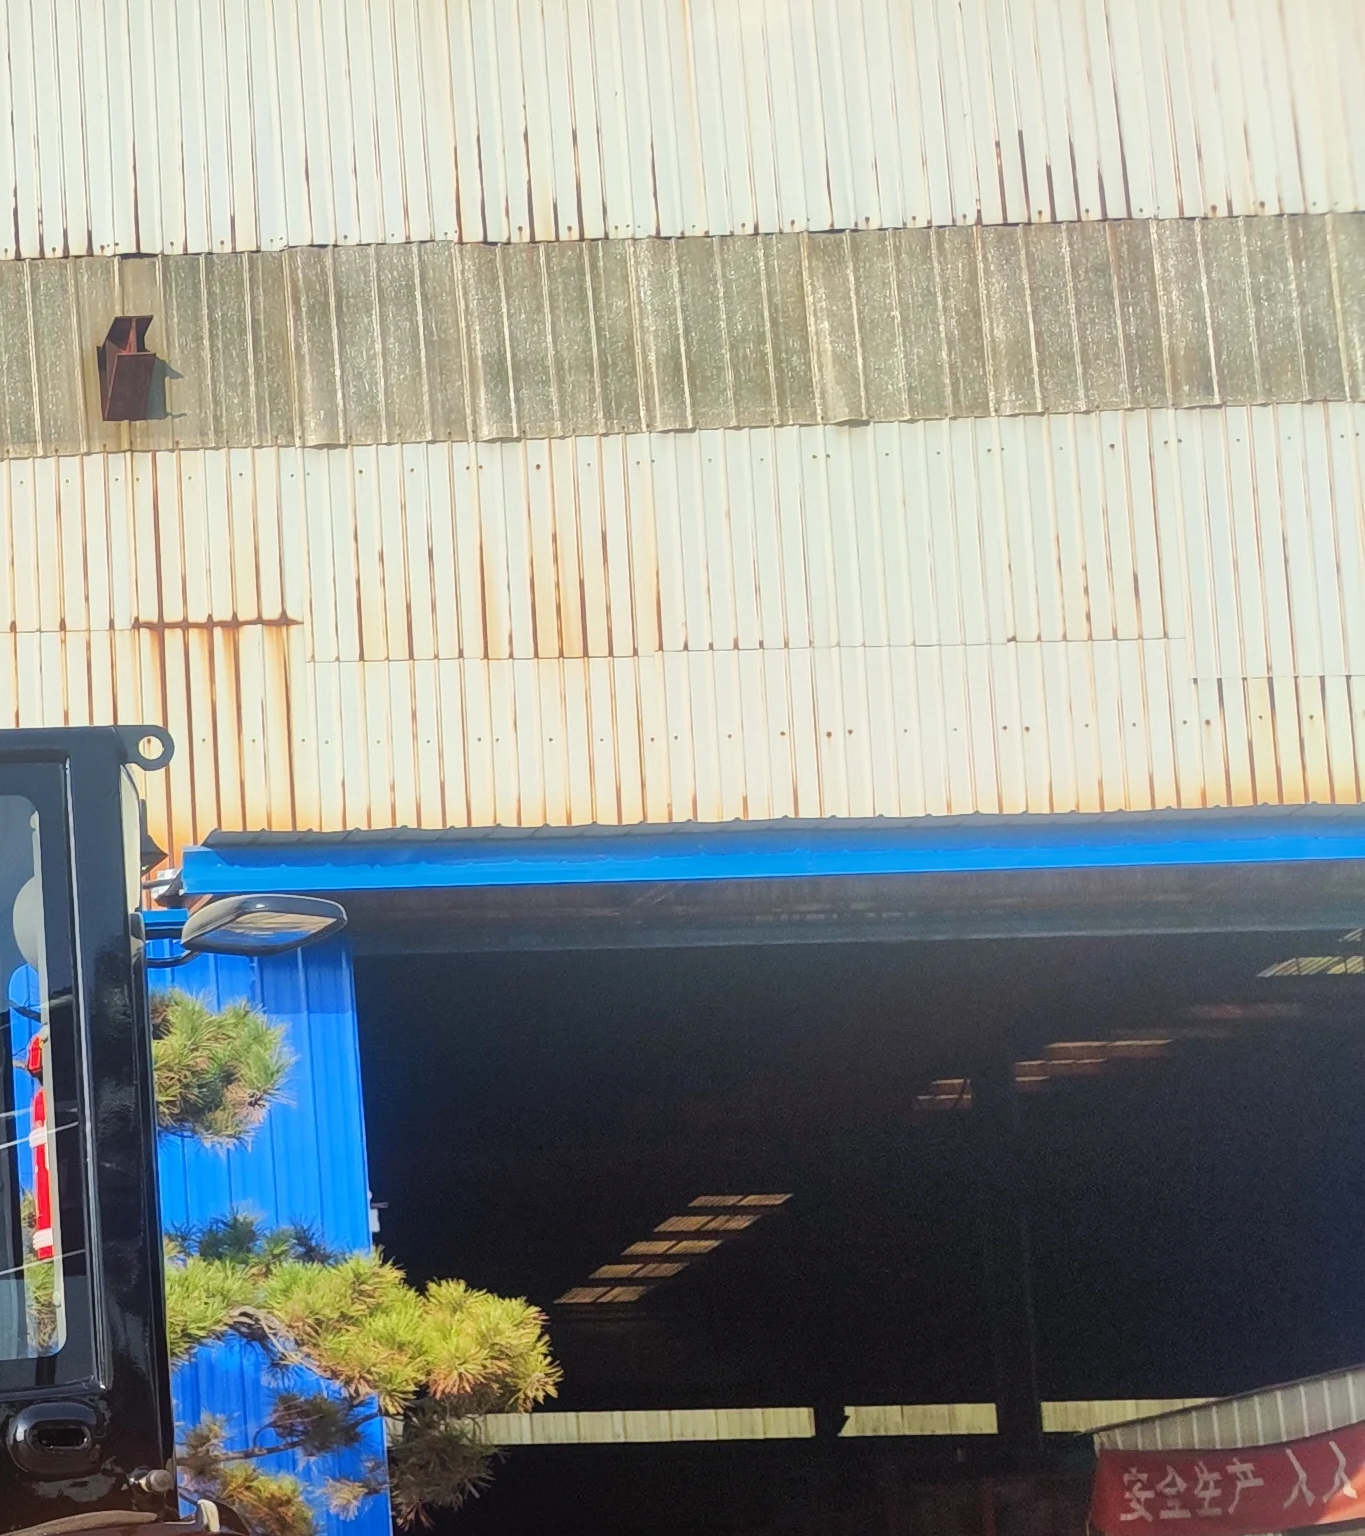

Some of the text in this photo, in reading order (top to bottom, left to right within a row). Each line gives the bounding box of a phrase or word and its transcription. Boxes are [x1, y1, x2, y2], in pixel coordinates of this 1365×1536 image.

[1119, 1440, 1359, 1522] 安全生产 人人
